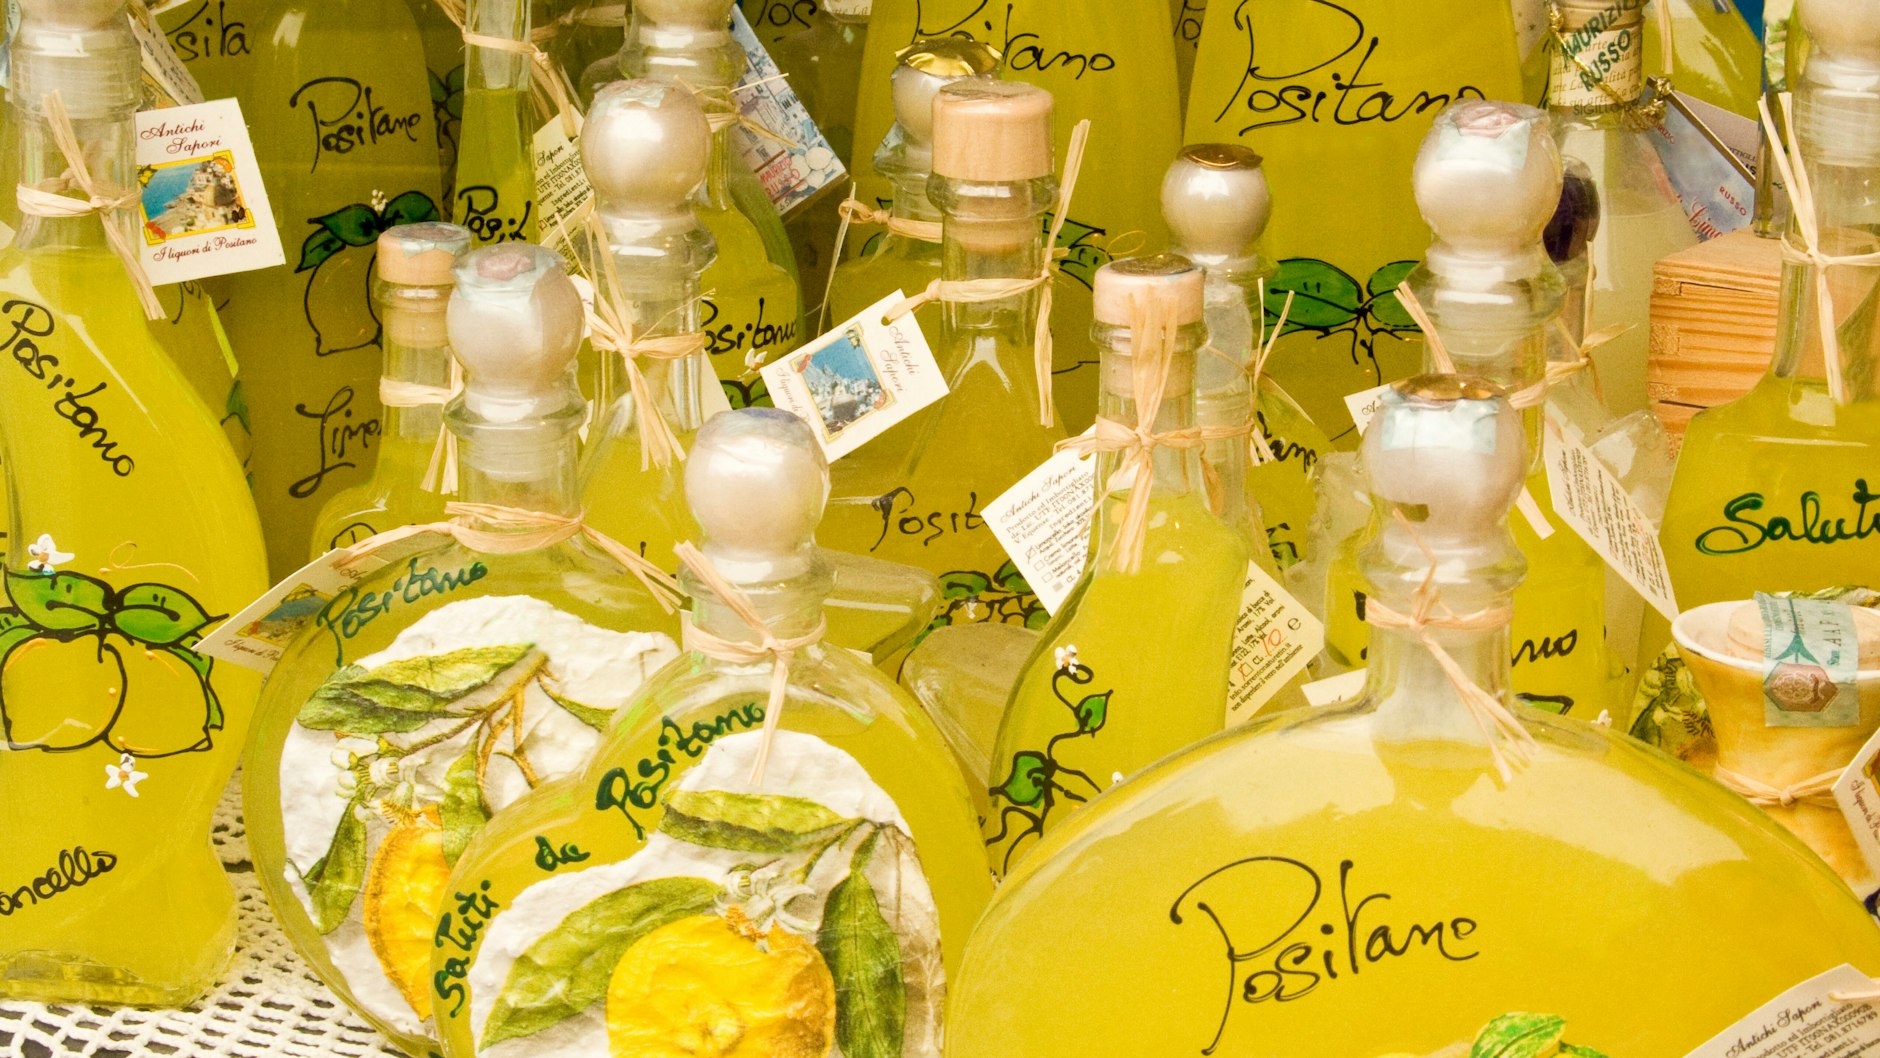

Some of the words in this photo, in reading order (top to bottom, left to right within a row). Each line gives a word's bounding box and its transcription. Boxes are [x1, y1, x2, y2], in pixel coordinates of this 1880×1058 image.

[1579, 29, 1631, 92] RUSSO
[140, 119, 206, 140] Antichi
[166, 136, 222, 156] Sapori
[290, 77, 421, 174] Positano
[1718, 186, 1747, 216] RUSSO
[168, 247, 200, 263] liquori
[201, 241, 213, 252] di
[213, 236, 258, 252] Positano
[889, 326, 920, 376] Antichi
[0, 300, 134, 477] Positano
[870, 486, 985, 552] Posit
[1001, 492, 1039, 520] Antichi
[1041, 466, 1075, 491] Sapori
[1049, 497, 1091, 529] Ingredienti
[316, 556, 489, 667] Positano
[595, 703, 766, 843] Positano
[0, 846, 118, 916] oncello
[535, 836, 591, 871] da
[1170, 856, 1479, 1056] Positano
[1726, 1023, 1778, 1058] Antichi
[1777, 1000, 1822, 1028] Sapori
